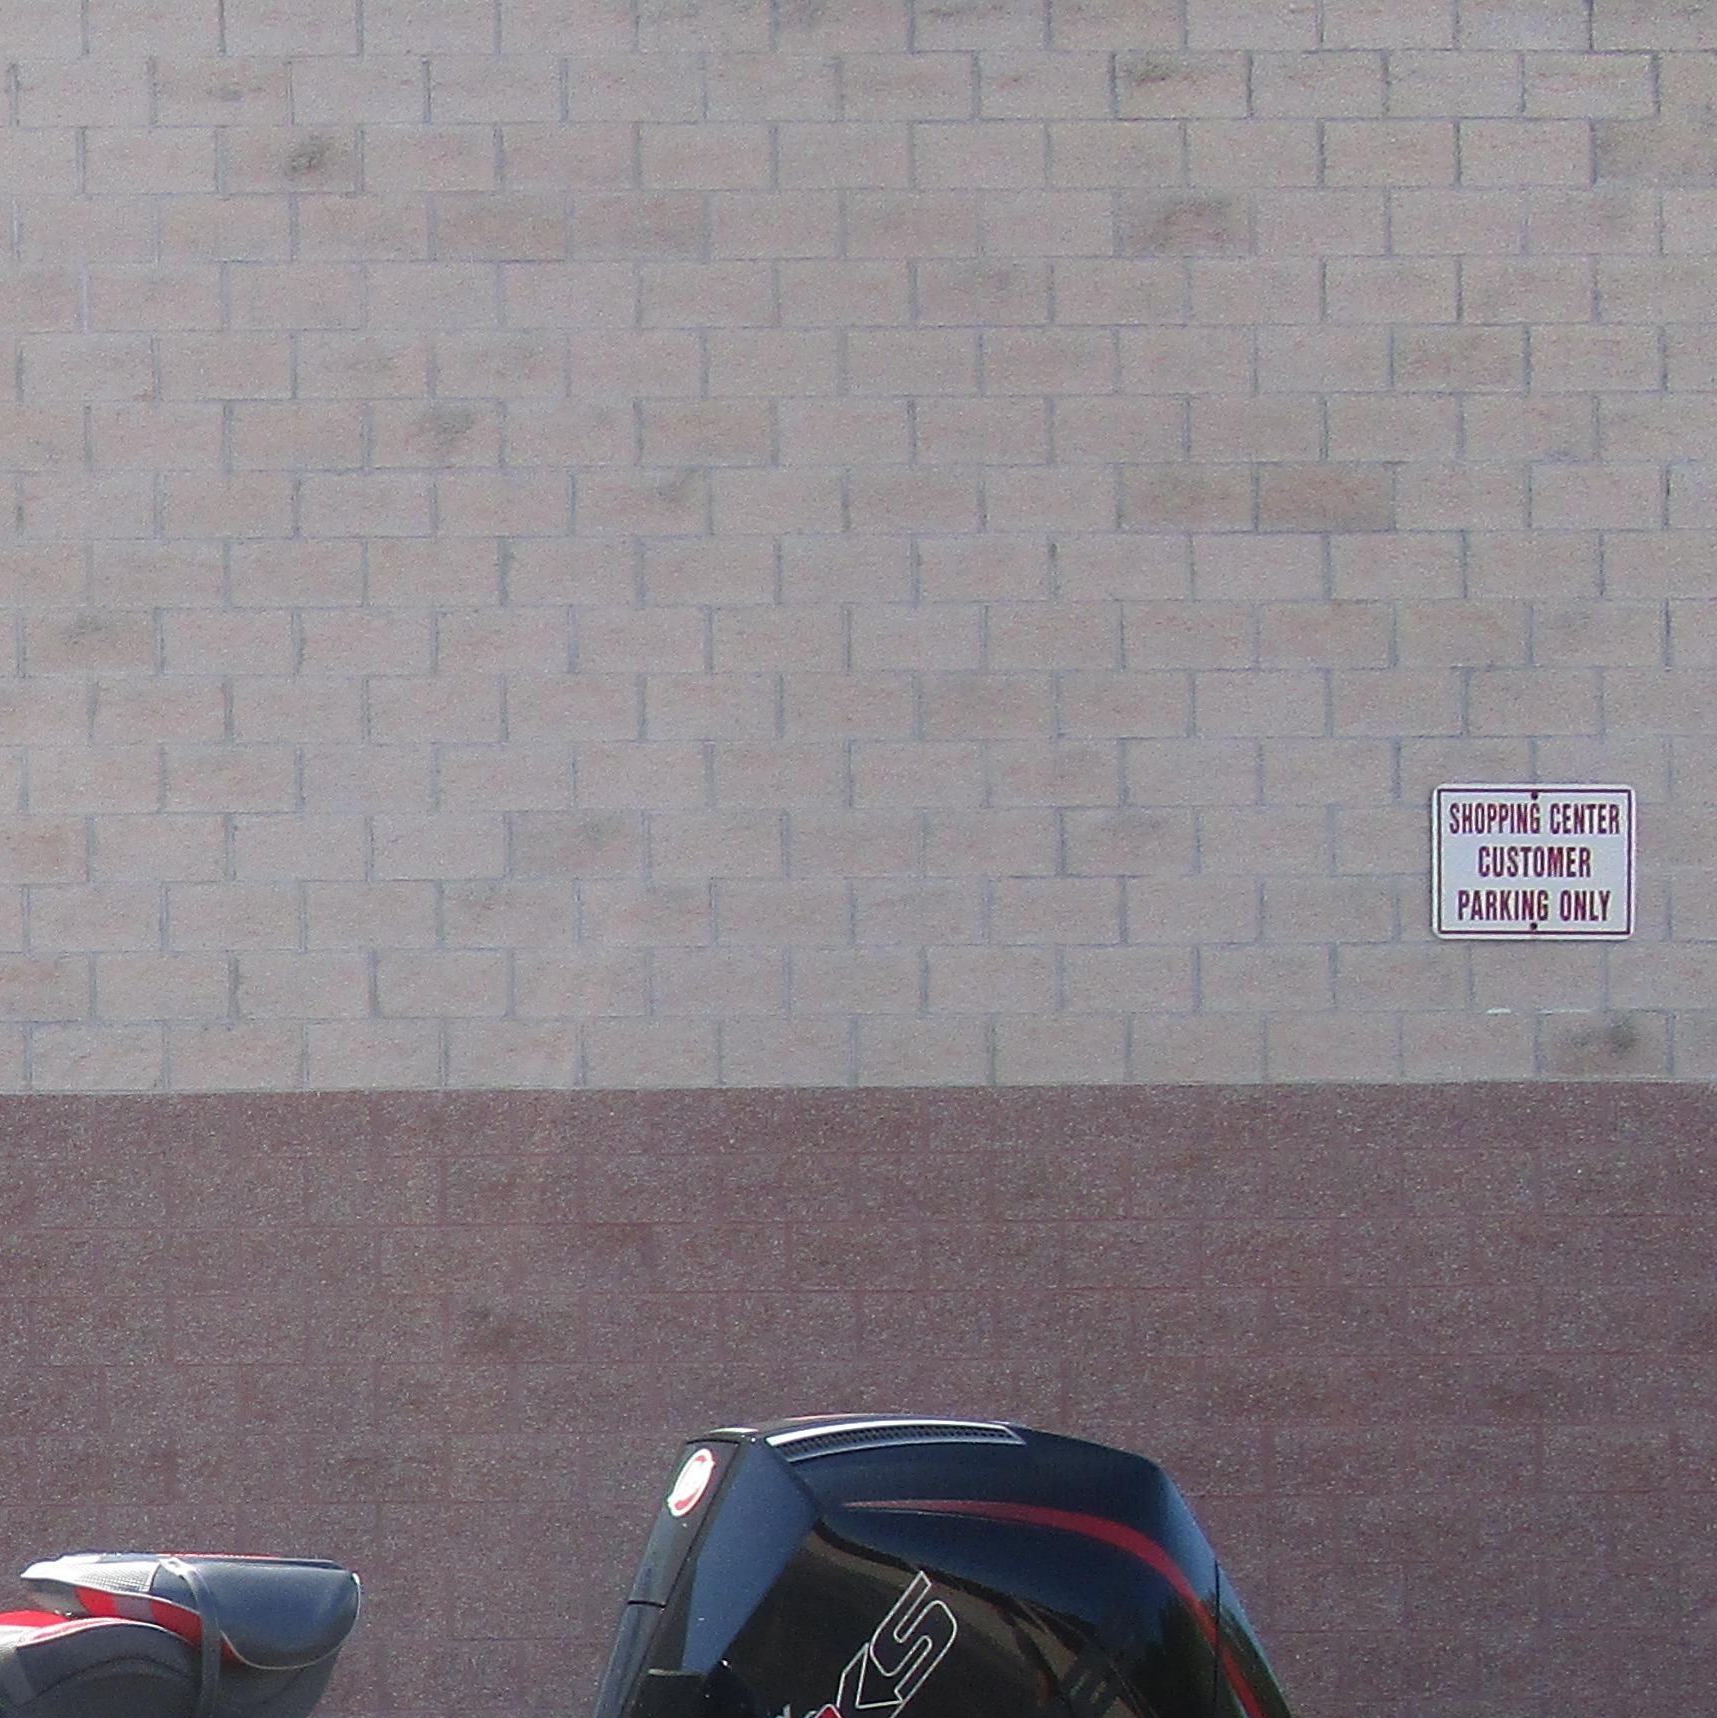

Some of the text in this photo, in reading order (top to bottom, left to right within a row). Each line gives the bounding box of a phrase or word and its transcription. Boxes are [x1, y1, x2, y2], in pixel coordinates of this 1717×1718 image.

[1449, 803, 1621, 835] SHOPPING CENTER
[1477, 846, 1592, 878] CUSTOMER
[1457, 890, 1611, 921] PARKING ONLY
